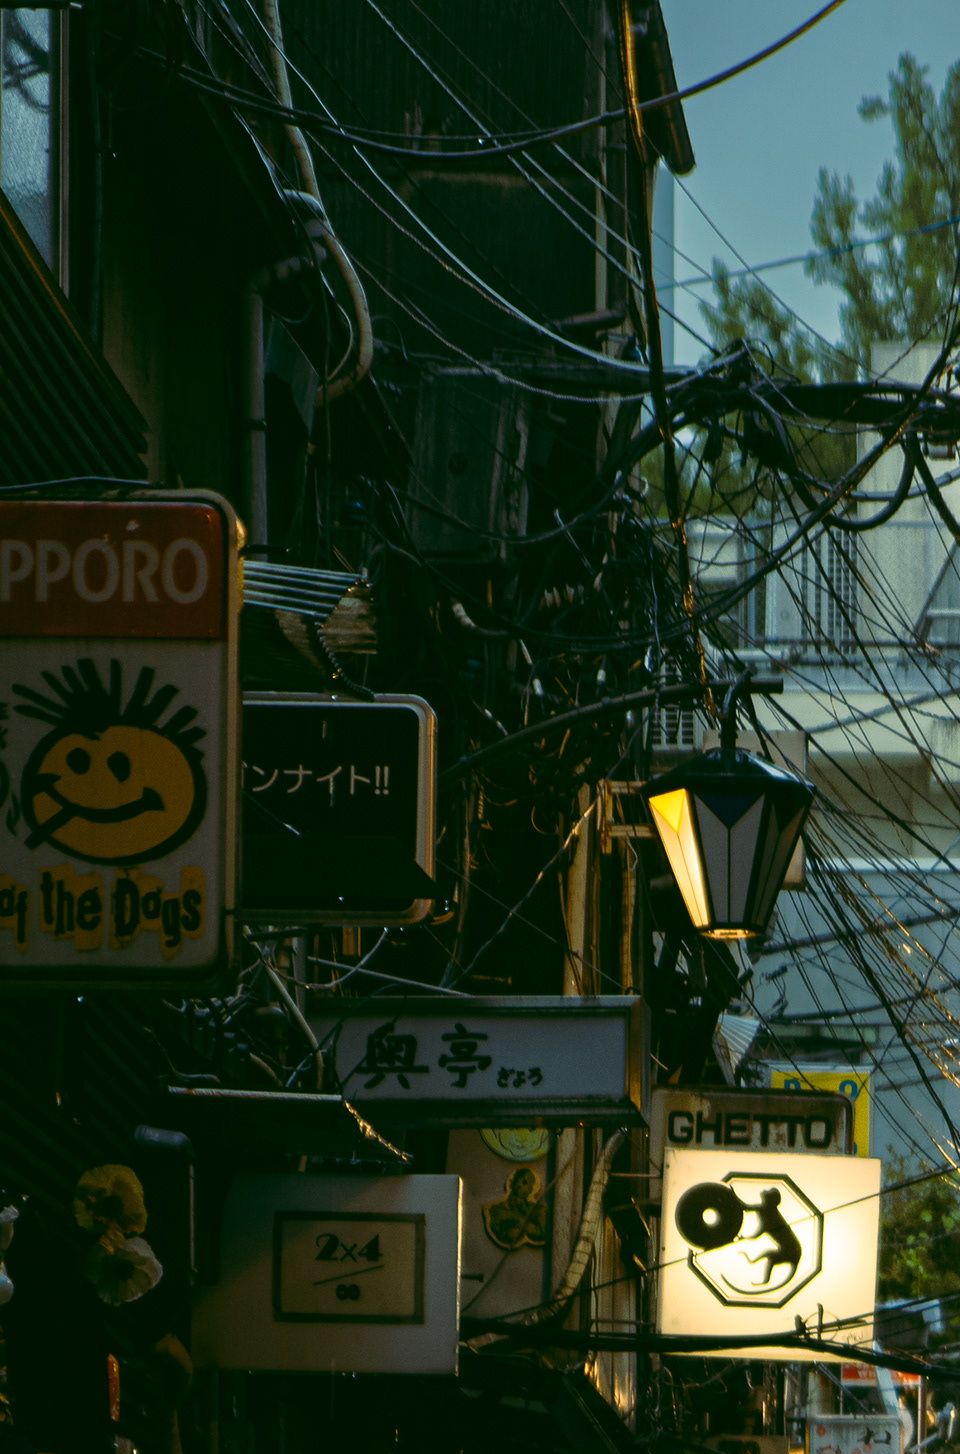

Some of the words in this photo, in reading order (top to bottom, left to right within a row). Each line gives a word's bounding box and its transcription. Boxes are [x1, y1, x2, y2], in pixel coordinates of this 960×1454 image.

[0, 538, 209, 604] PPORO
[242, 761, 390, 797] ンナイト!!
[41, 871, 102, 937] the
[115, 877, 201, 948] Dogs
[667, 1111, 832, 1148] GHETTO
